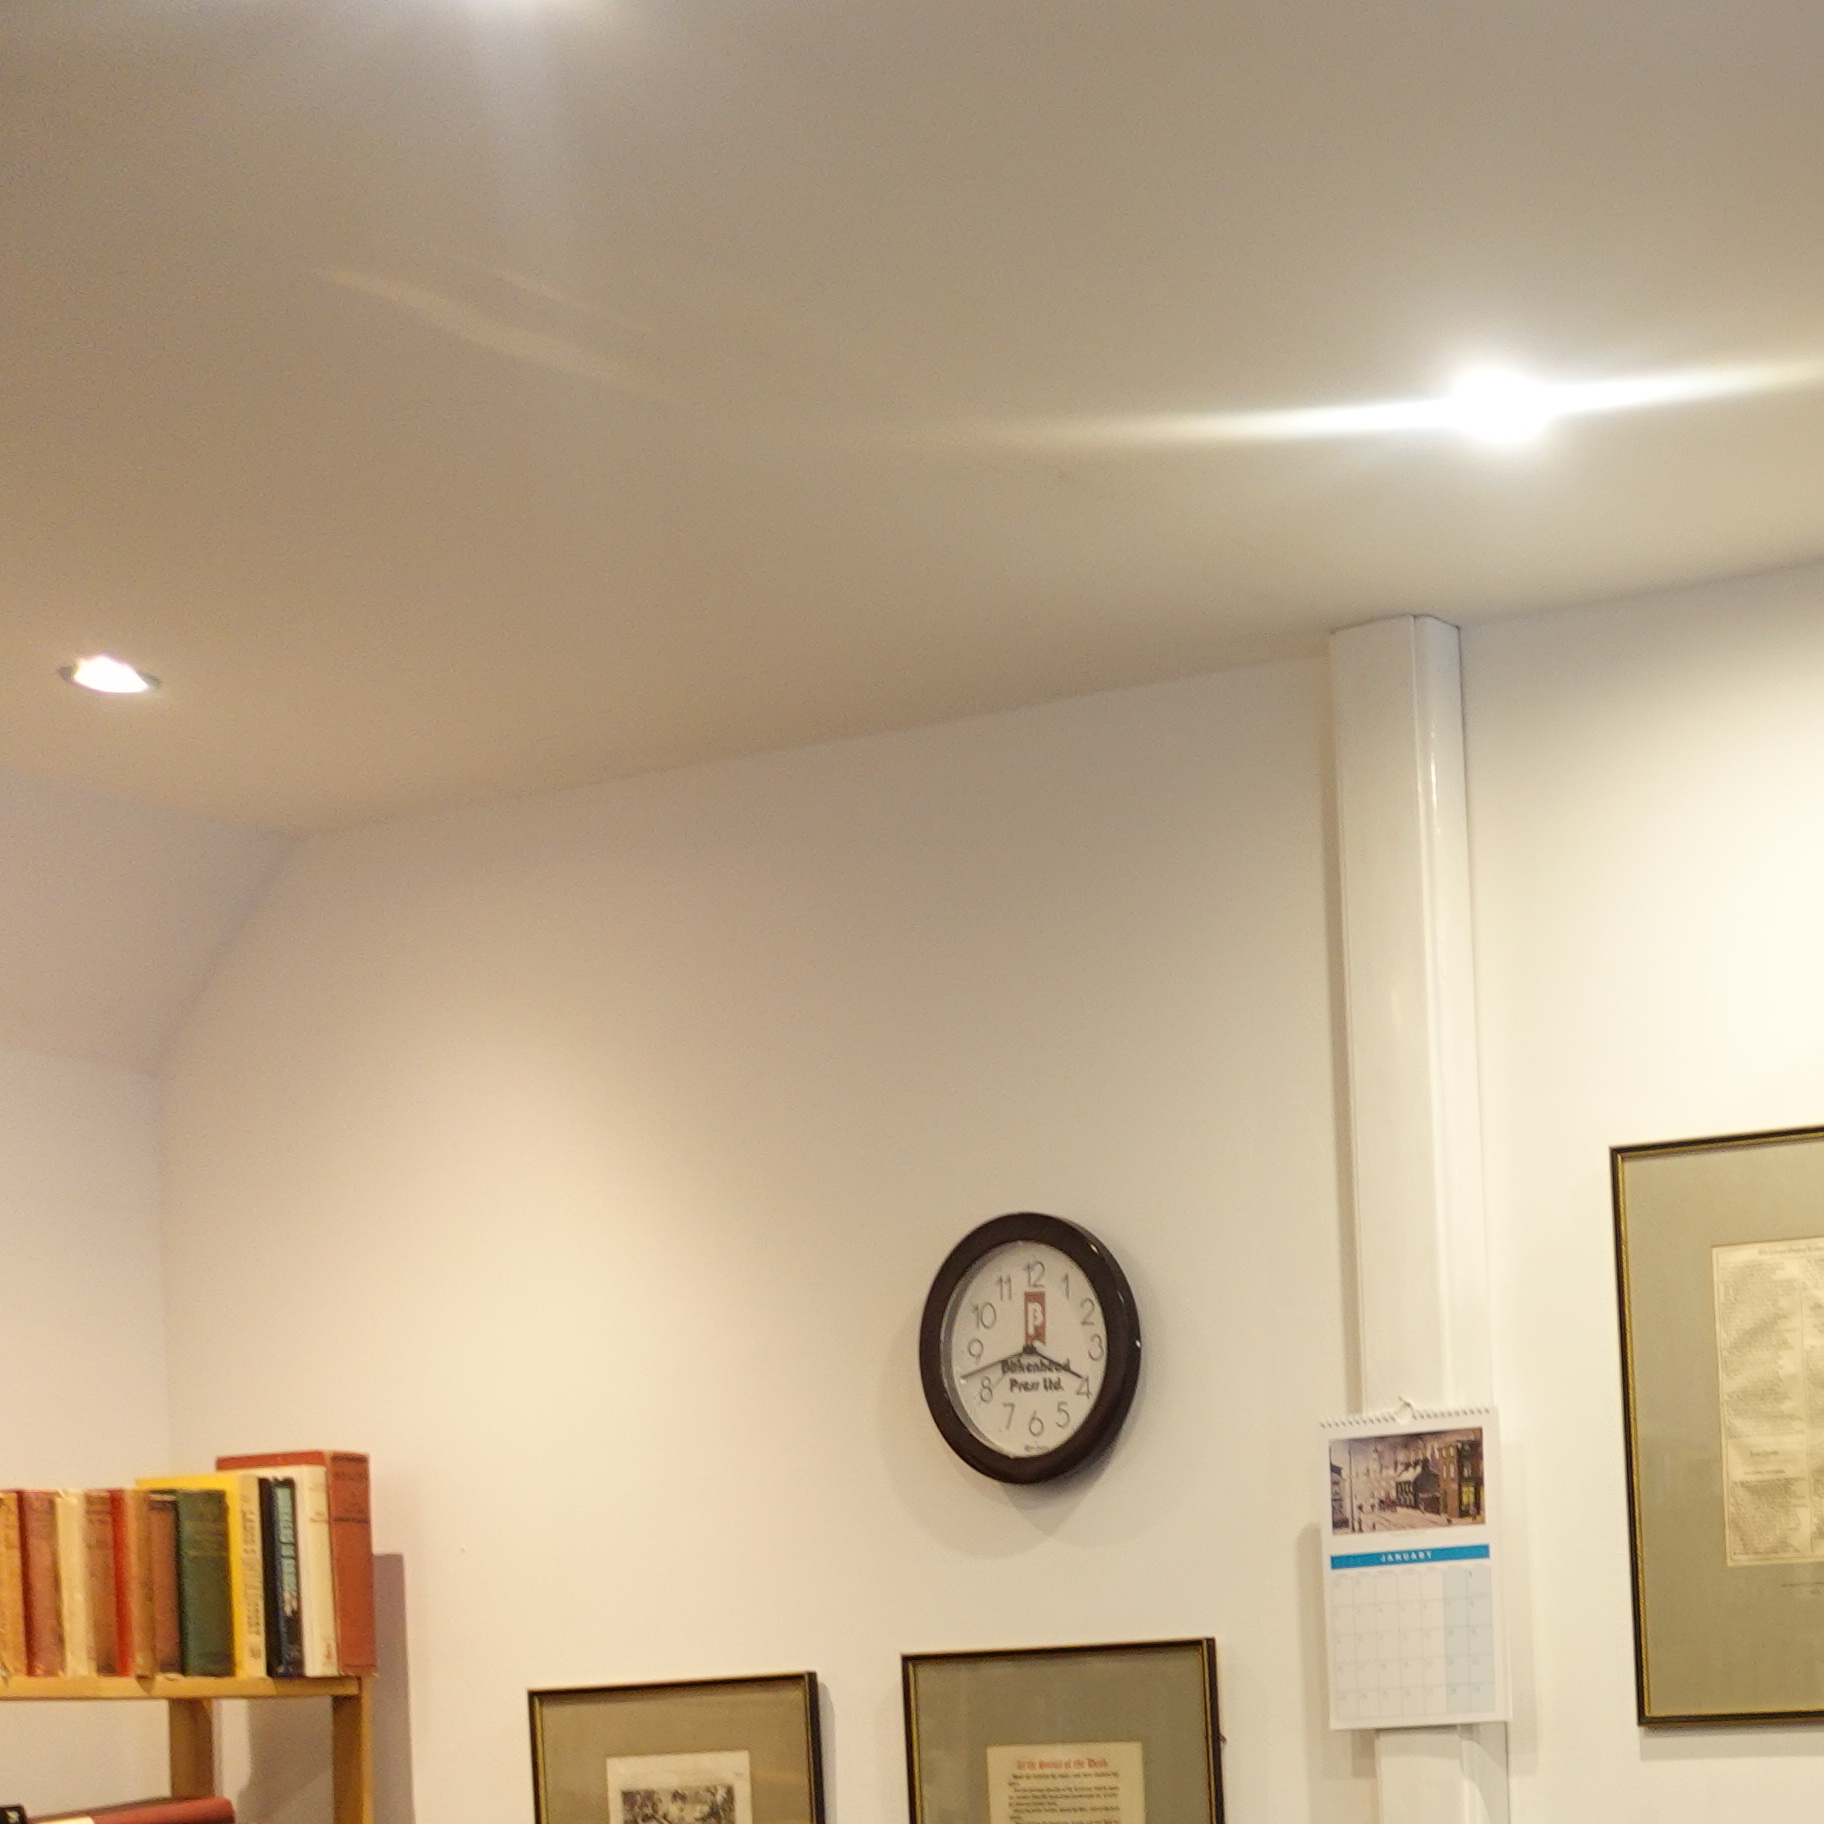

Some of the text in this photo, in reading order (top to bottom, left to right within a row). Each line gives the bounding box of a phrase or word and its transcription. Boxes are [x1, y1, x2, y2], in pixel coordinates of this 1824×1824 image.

[997, 1275, 1012, 1300] 11
[1024, 1261, 1046, 1288] 12
[1061, 1273, 1070, 1299] 1
[972, 1302, 997, 1329] 10
[1080, 1299, 1095, 1326] 2
[968, 1339, 984, 1364] 9
[1088, 1334, 1103, 1361] 3
[979, 1376, 992, 1403] 8
[1076, 1376, 1092, 1399] 4
[1002, 1403, 1016, 1429] 7
[1028, 1410, 1044, 1437] 6
[1054, 1402, 1070, 1429] 5
[1380, 1549, 1433, 1562] JANUARY
